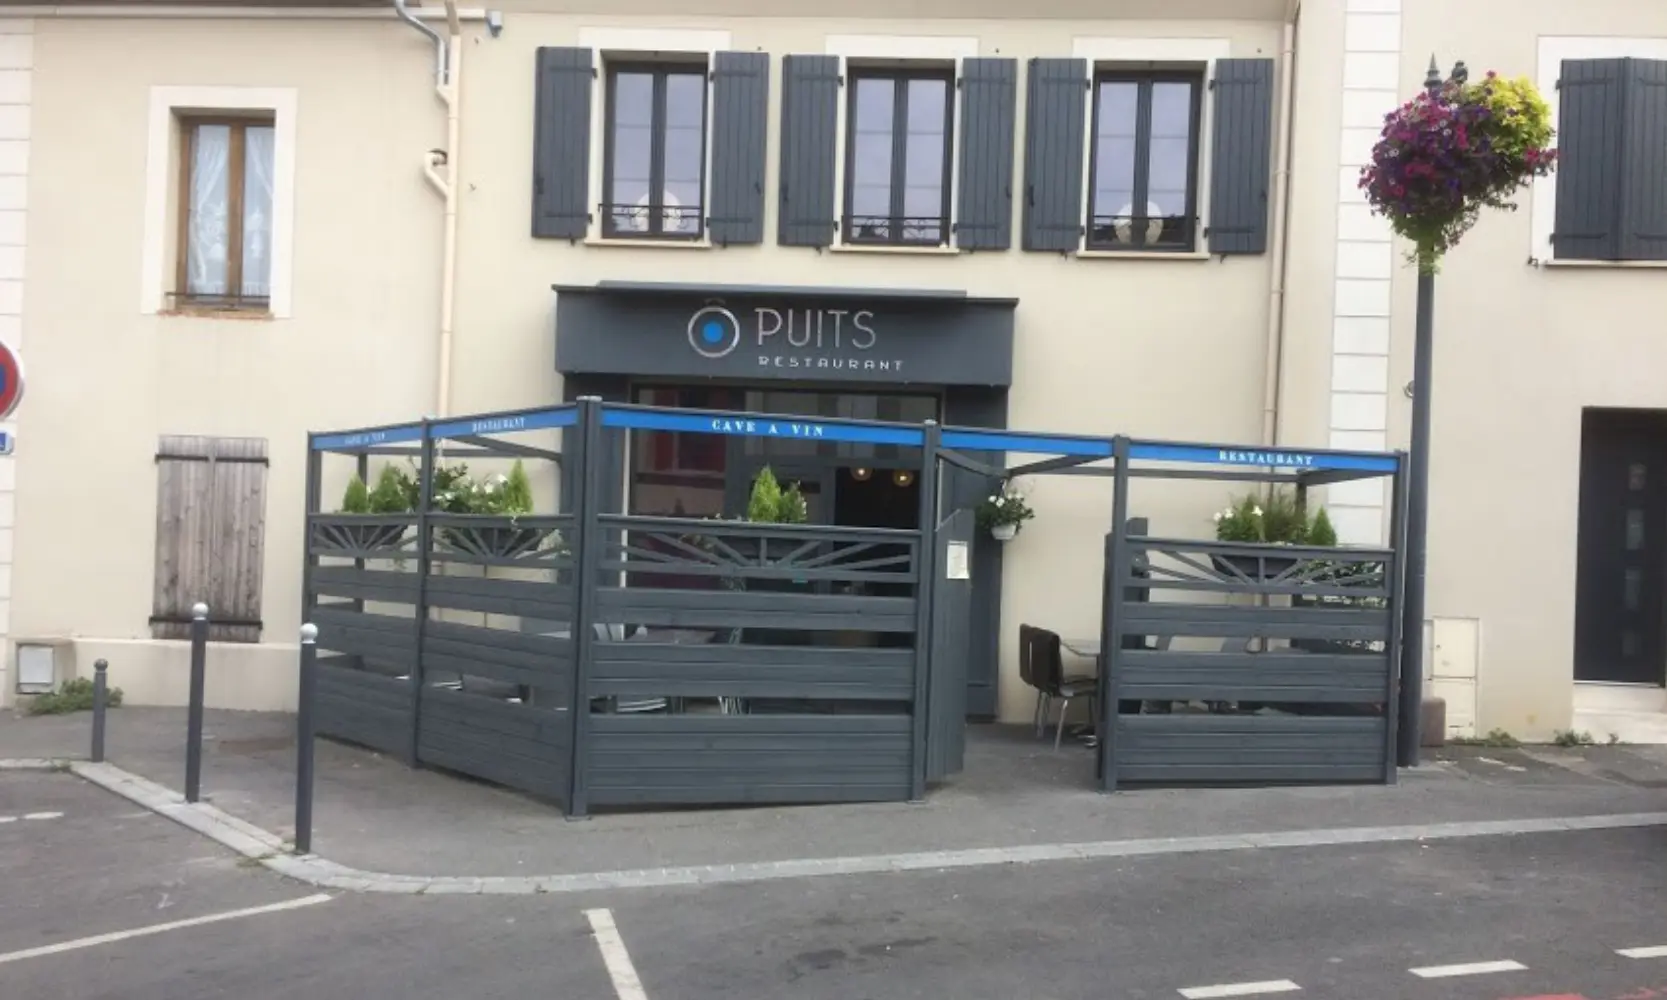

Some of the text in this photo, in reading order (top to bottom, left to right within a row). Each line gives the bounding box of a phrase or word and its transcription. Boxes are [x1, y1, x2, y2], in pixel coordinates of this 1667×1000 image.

[754, 307, 876, 349] PUITS
[758, 356, 904, 371] RESTAURANT
[711, 419, 823, 436] CAVE A VIN
[1219, 450, 1313, 466] RESTAURANT
